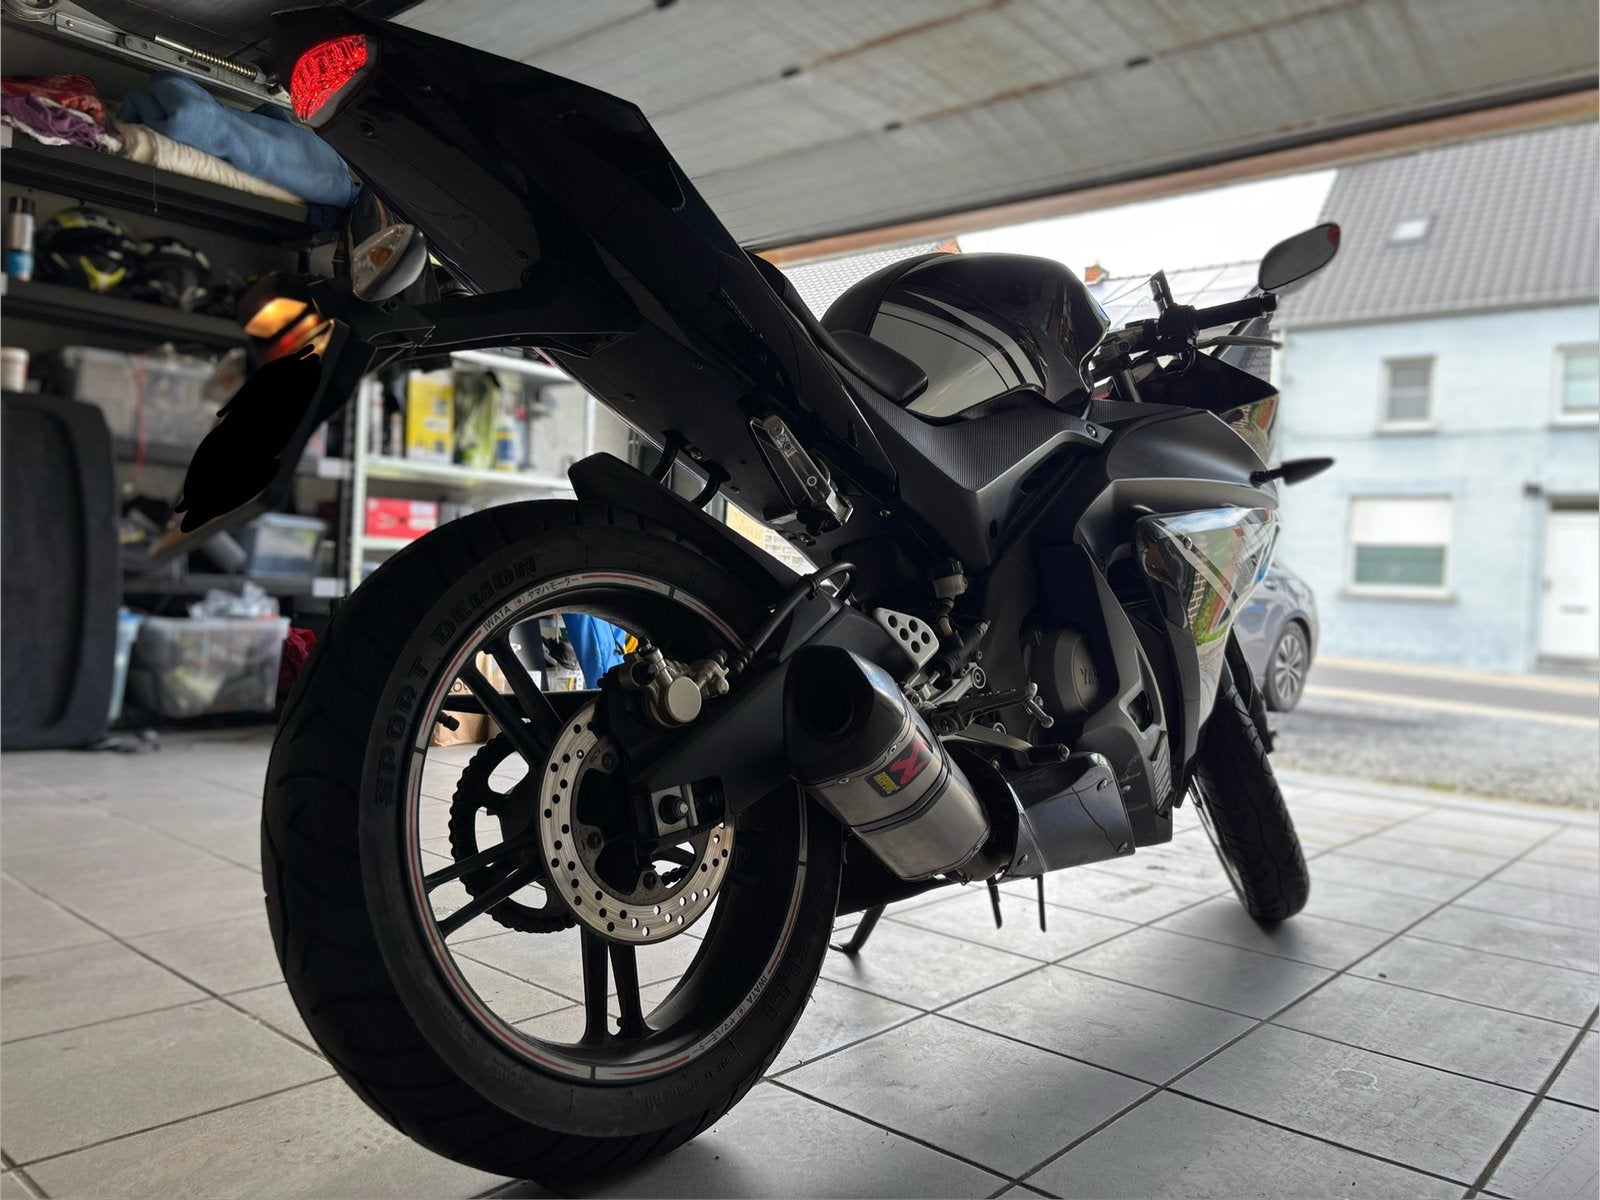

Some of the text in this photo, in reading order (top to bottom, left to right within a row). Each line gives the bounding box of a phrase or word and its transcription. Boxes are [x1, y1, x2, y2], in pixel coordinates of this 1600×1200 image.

[482, 605, 513, 633] IWATA
[374, 555, 538, 807] SPORT DEMON
[745, 975, 769, 1004] IWATA
